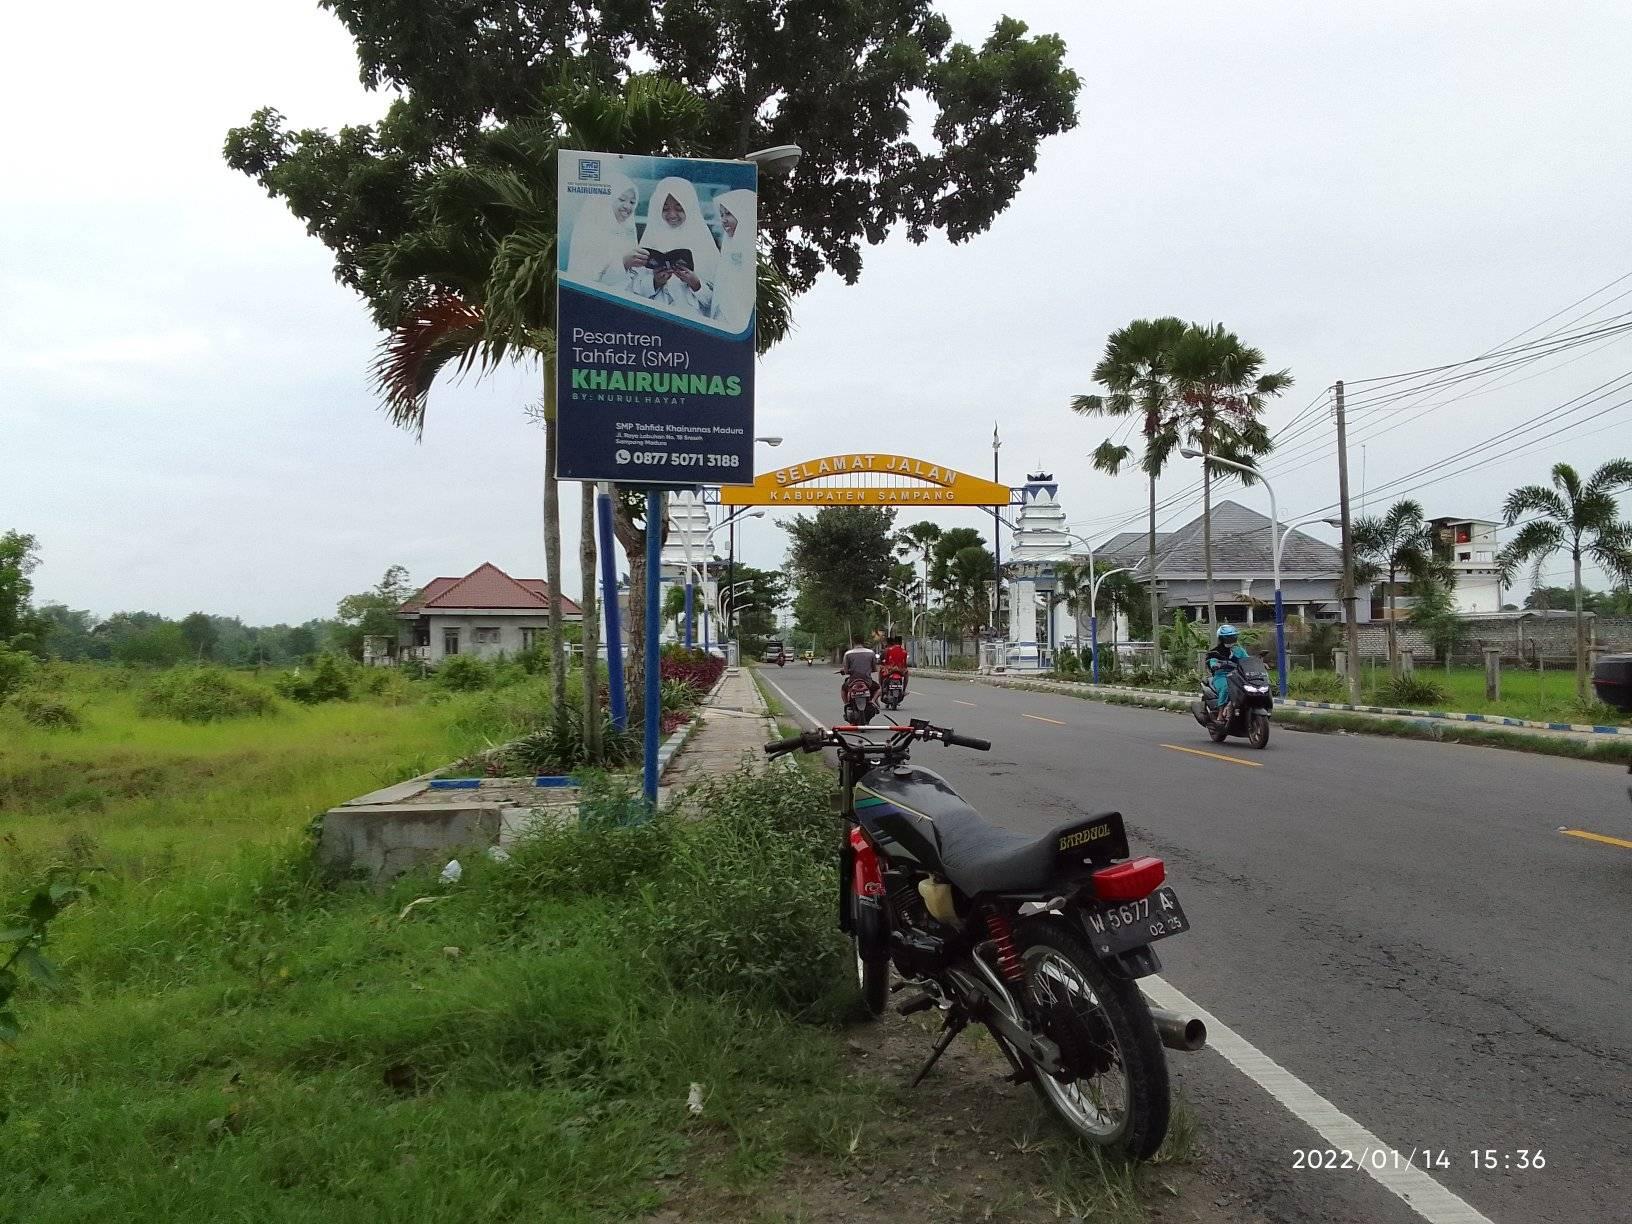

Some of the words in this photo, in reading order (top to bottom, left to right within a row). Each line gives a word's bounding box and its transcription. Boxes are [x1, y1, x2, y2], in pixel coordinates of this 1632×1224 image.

[567, 186, 612, 195] KHAIRUNNAS
[573, 327, 662, 347] Pesantren
[572, 347, 637, 365] Tahfidz
[642, 349, 690, 370] (SMP)
[572, 368, 742, 396] KHAIRUNNAS
[598, 394, 641, 403] NURUL
[644, 396, 686, 405] HAYAT
[615, 422, 634, 431] SMP
[636, 423, 665, 432] Tahfidz
[666, 424, 711, 434] Khairunnas
[713, 426, 744, 435] Madura
[615, 439, 644, 447] Sampang
[633, 451, 668, 465] 0877
[671, 453, 704, 466] 5071
[707, 454, 740, 467] 3188
[775, 455, 876, 484] SELAMAT
[886, 456, 957, 484] JALAN
[770, 491, 865, 501] KABUPATEN
[878, 491, 955, 501] SAMPANG
[1089, 914, 1106, 934] W
[1108, 898, 1150, 929] 5677
[1159, 892, 1174, 911] A
[1150, 922, 1166, 936] 02
[1167, 917, 1182, 930] 25
